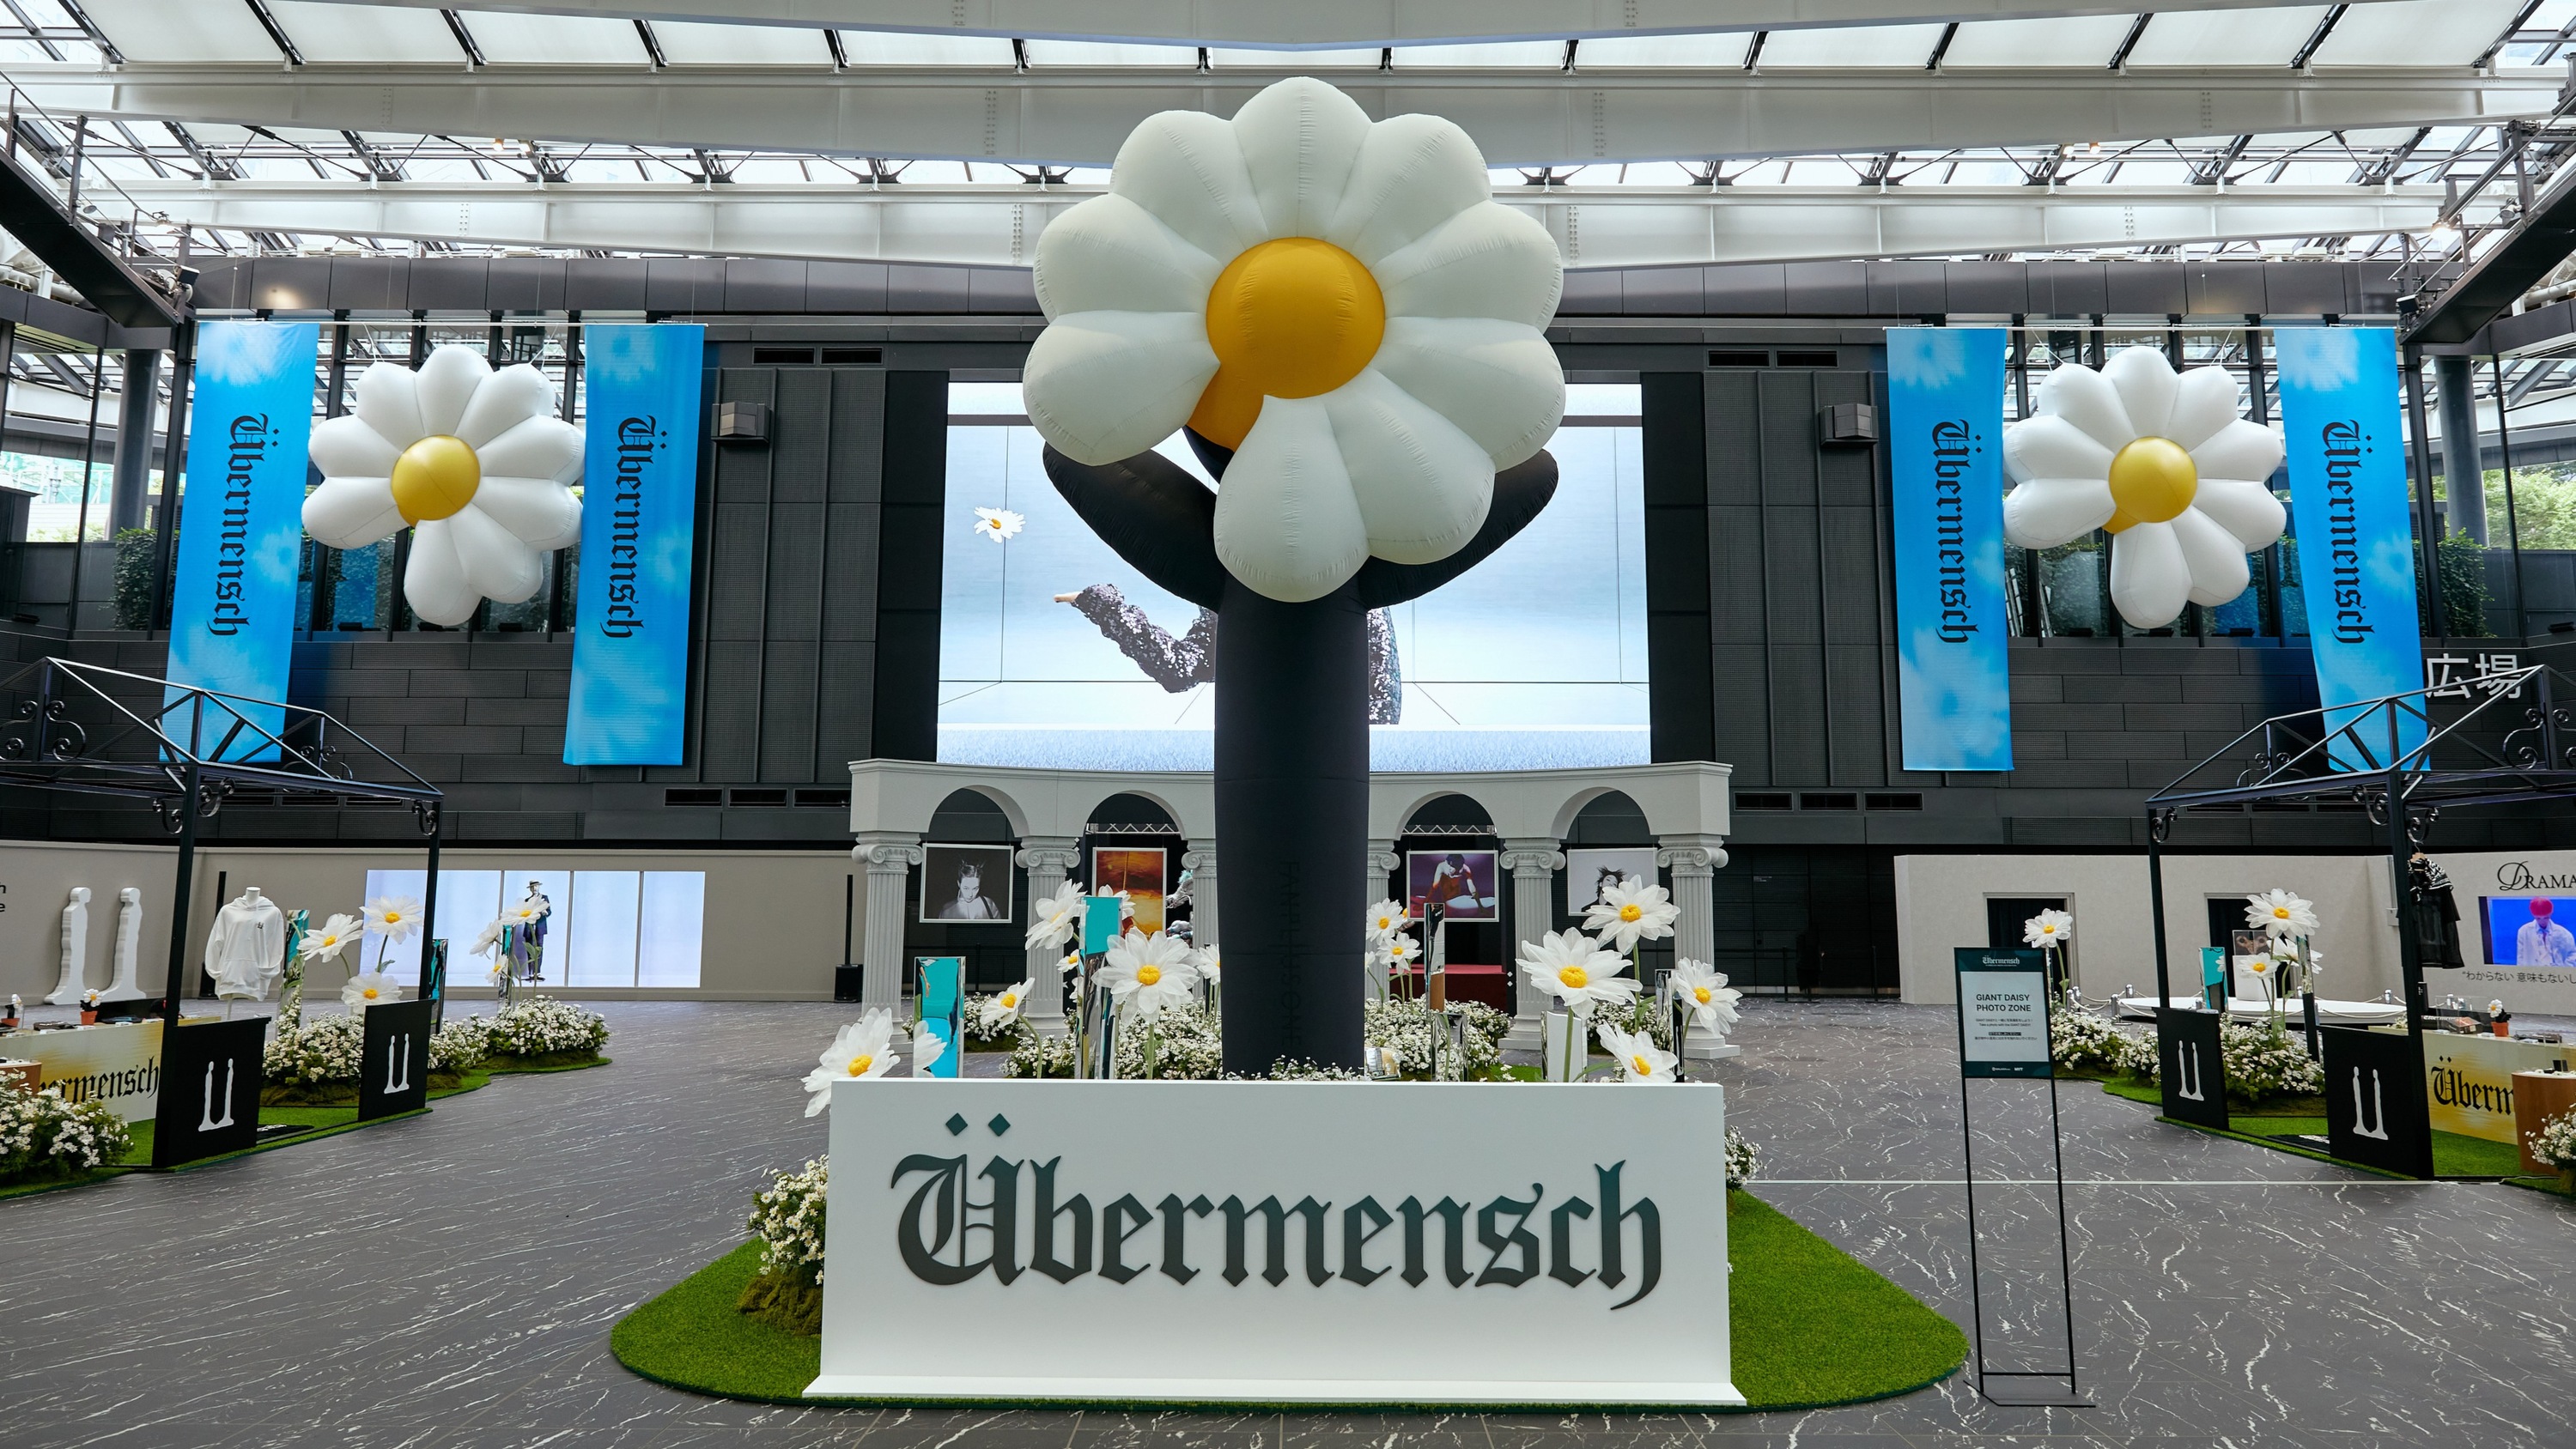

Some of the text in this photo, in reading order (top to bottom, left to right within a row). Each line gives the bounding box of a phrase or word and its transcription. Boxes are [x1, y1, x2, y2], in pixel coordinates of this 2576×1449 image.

[207, 413, 280, 635] Übermensch
[599, 415, 667, 638] Übermensch
[1932, 419, 1982, 643] Übermensch
[2322, 419, 2375, 644] Übermensch
[2425, 653, 2522, 699] 広場
[39, 1055, 160, 1105] rmensch
[890, 1112, 1662, 1312] Übermensch
